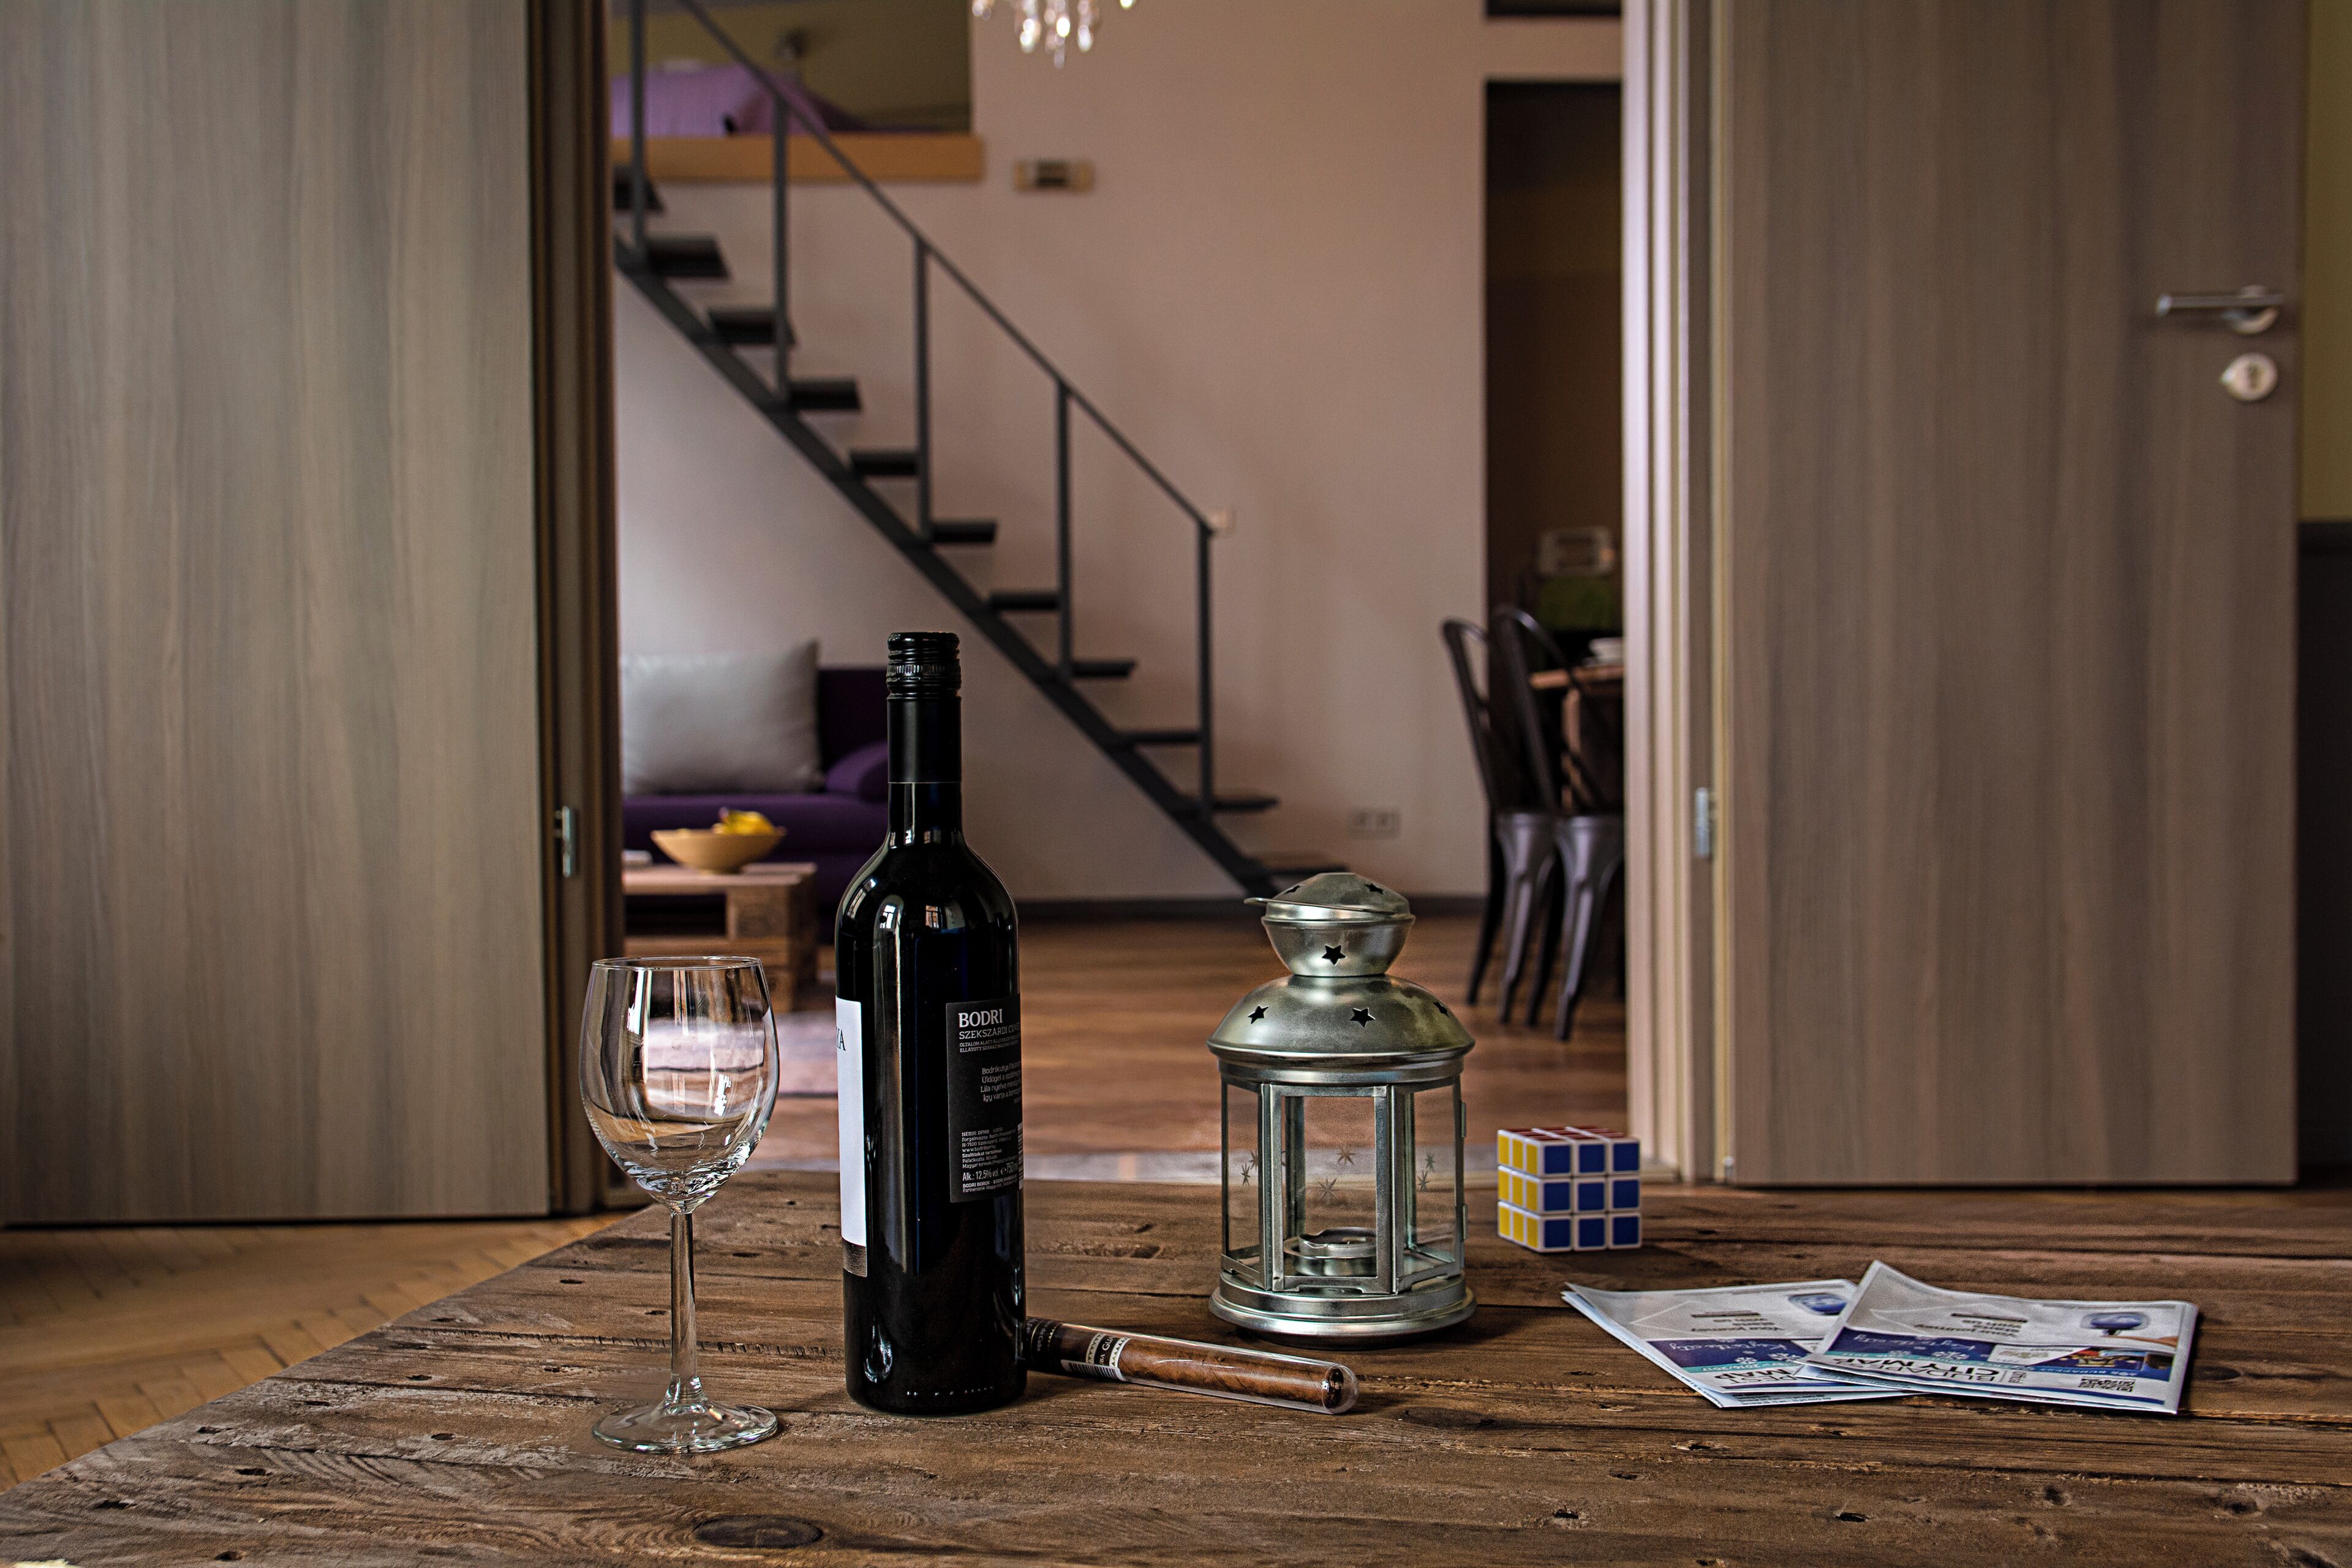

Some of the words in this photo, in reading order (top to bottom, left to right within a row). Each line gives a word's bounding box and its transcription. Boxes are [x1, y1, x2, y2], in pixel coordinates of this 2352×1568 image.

[958, 1009, 1003, 1028] BODRI
[1833, 1358, 1915, 1366] MAP
[1714, 1369, 1791, 1379] MAP
[1836, 1361, 1996, 1382] BUDAPEST
[1920, 1363, 2000, 1376] CITY
